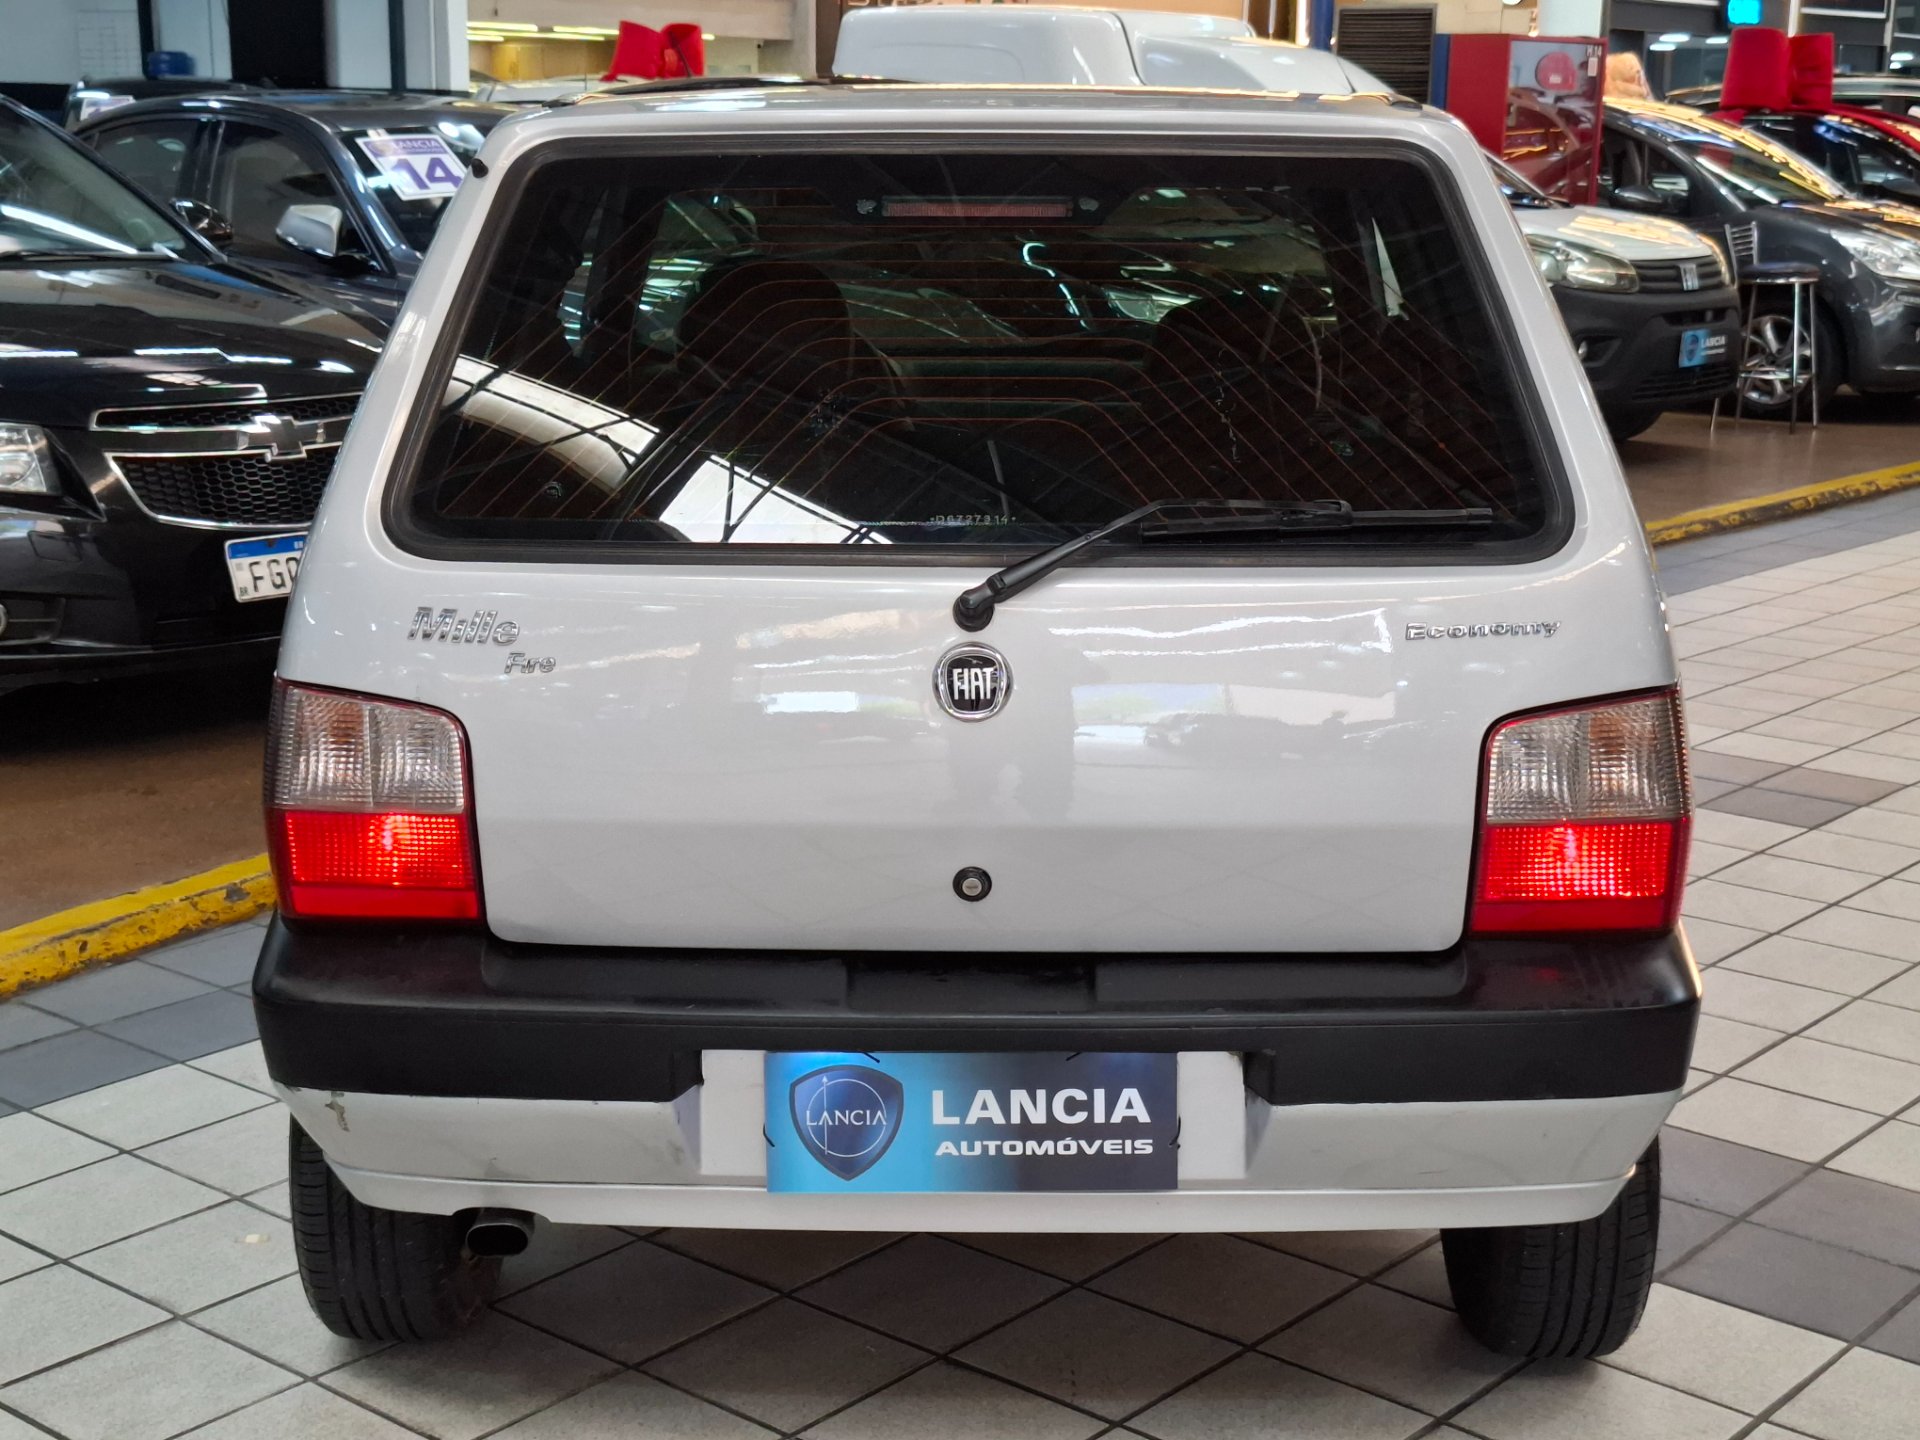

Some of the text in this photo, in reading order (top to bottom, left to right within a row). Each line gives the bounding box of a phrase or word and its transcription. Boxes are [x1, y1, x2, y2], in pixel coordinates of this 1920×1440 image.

[391, 157, 463, 190] 14
[407, 607, 520, 645] Mille
[1405, 622, 1560, 640] Economy
[504, 652, 556, 674] Fire
[952, 667, 995, 700] FIAT
[806, 1109, 887, 1127] LANCIA
[931, 1087, 1152, 1125] LANCIA
[935, 1137, 1154, 1156] AUTOMÓVEIS
